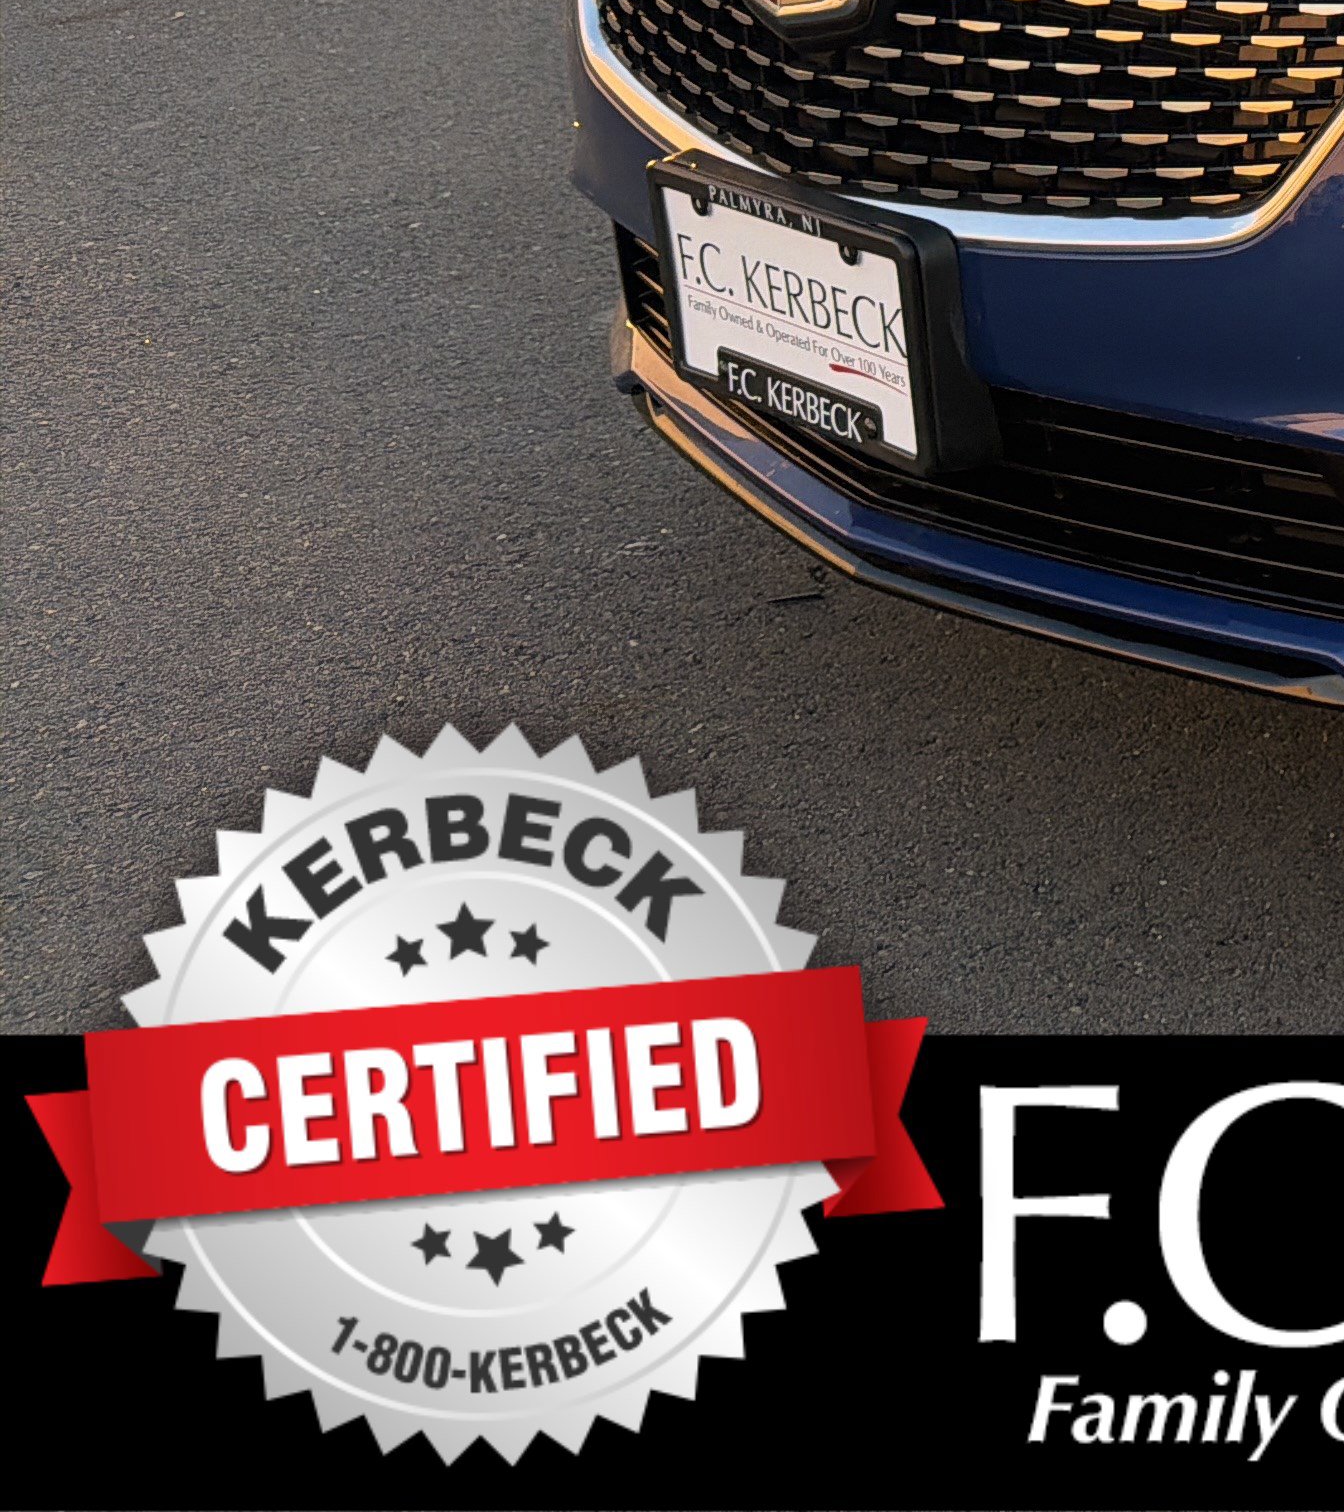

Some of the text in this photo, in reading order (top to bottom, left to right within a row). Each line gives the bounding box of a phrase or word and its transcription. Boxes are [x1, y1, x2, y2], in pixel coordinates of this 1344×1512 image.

[708, 184, 822, 238] PALMYRA, NJ
[676, 233, 907, 358] F.C. KERBECK
[687, 294, 907, 388] Family Owned & Operated For Over 100 Years
[727, 362, 863, 443] F.C. KERBECK
